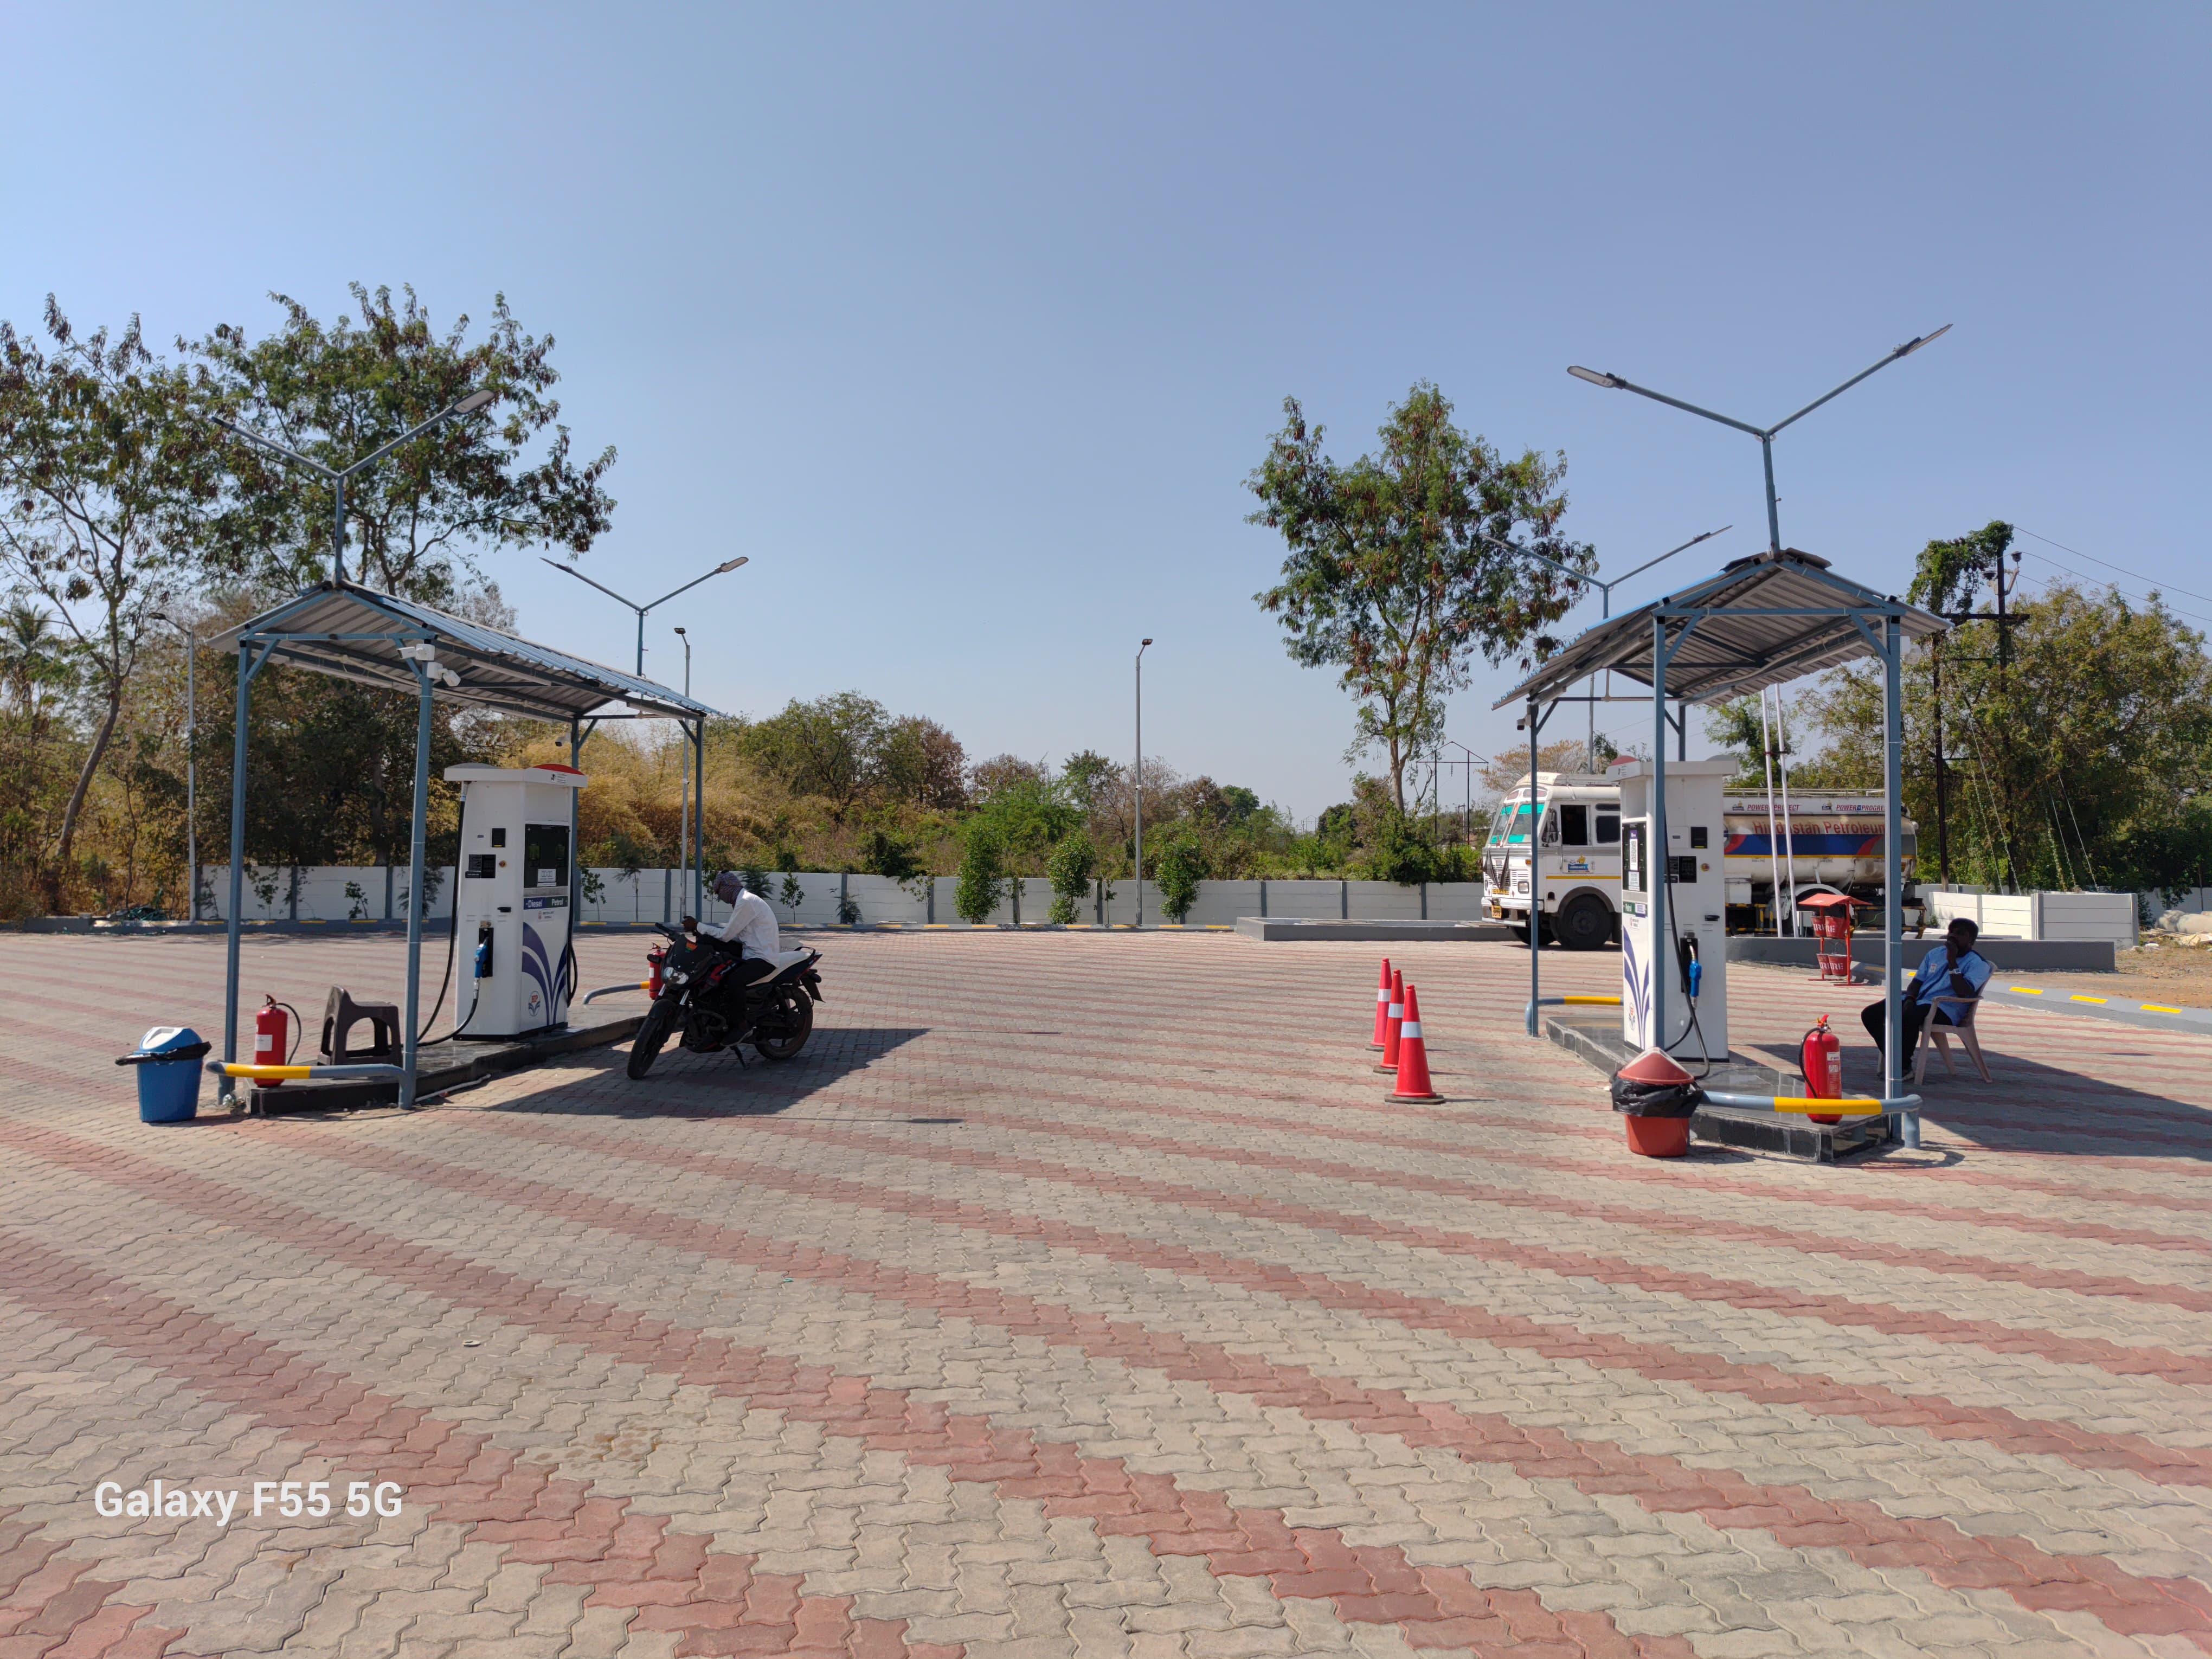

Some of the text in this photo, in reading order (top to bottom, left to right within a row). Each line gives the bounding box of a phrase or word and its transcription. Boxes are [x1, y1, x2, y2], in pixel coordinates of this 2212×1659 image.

[1752, 820, 1821, 834] Hidstan
[528, 898, 564, 908] Diesel Petrol
[531, 995, 538, 1003] HP
